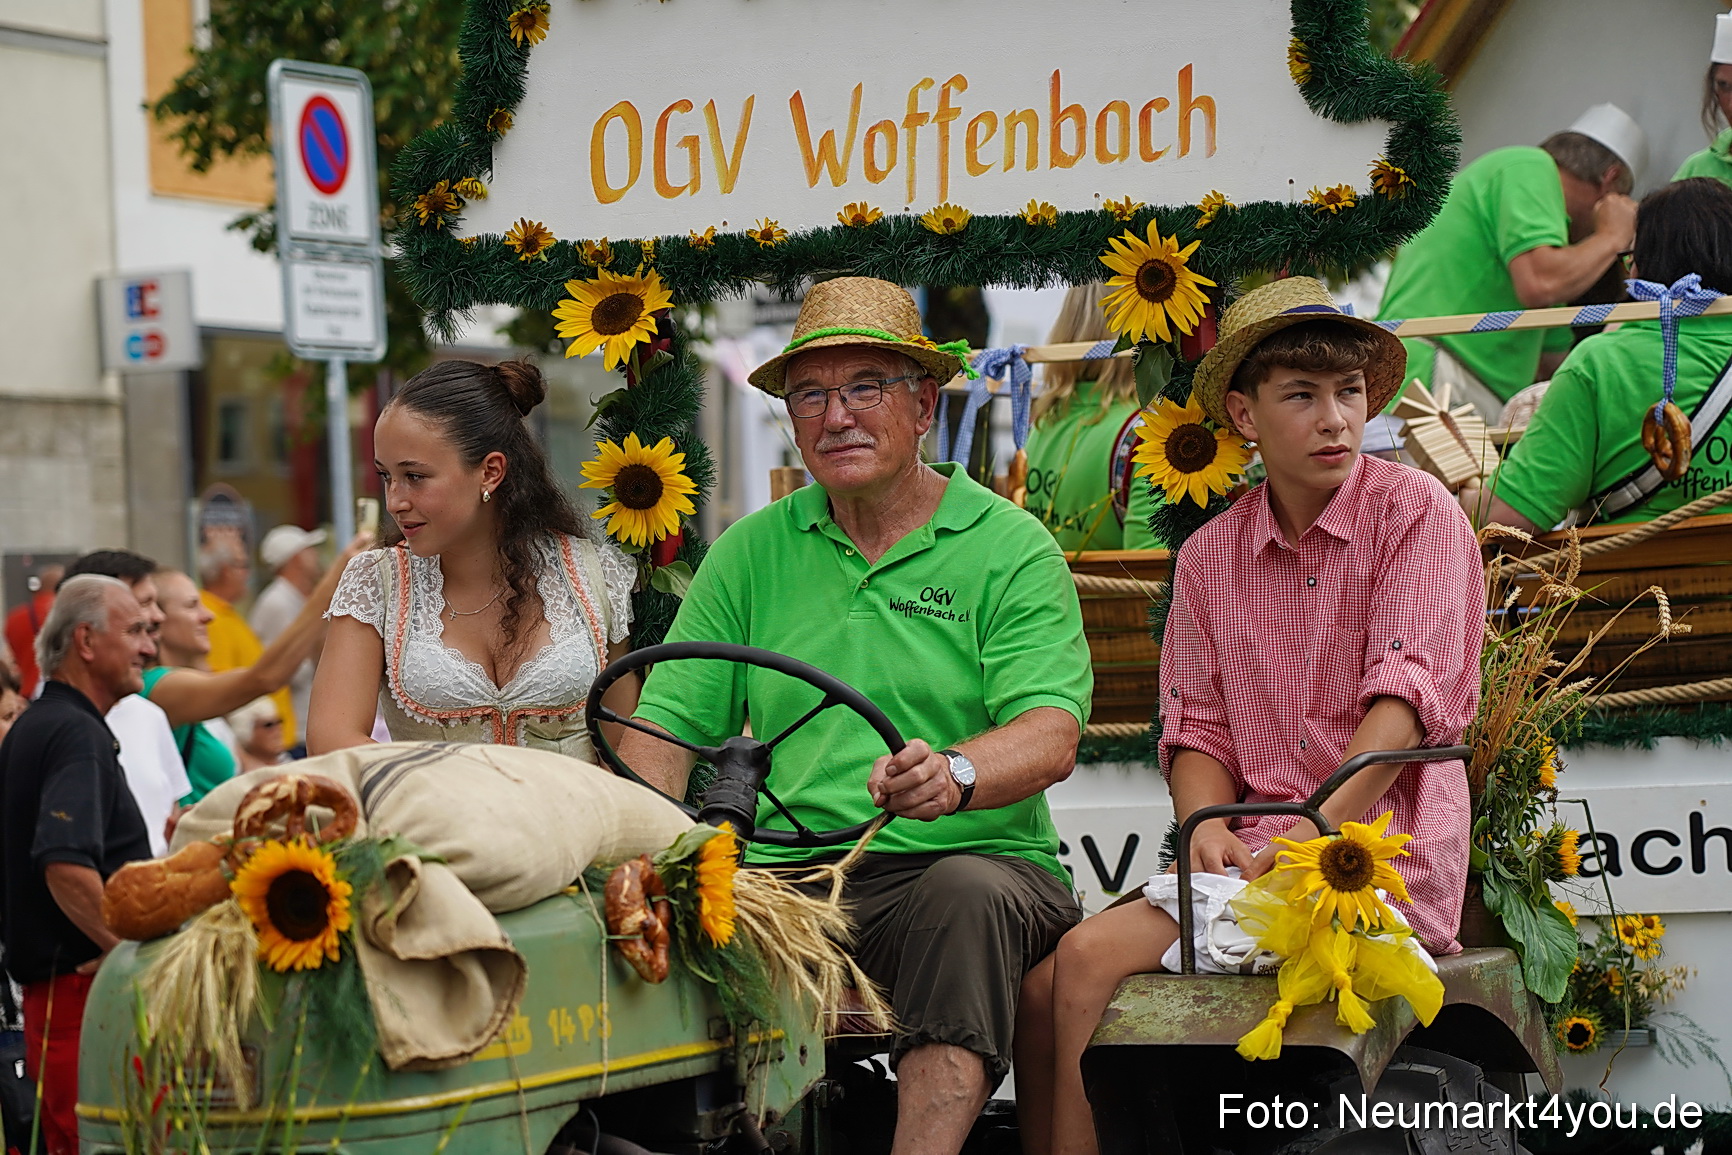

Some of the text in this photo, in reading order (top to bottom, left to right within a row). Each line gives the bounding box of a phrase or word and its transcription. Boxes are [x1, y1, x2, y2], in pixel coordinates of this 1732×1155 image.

[590, 63, 1218, 204] OGV Woffenbach
[308, 202, 349, 229] ZONE
[1705, 436, 1732, 466] O
[1026, 468, 1061, 499] OG
[889, 596, 956, 621] Woffenbach
[919, 586, 957, 606] OGV
